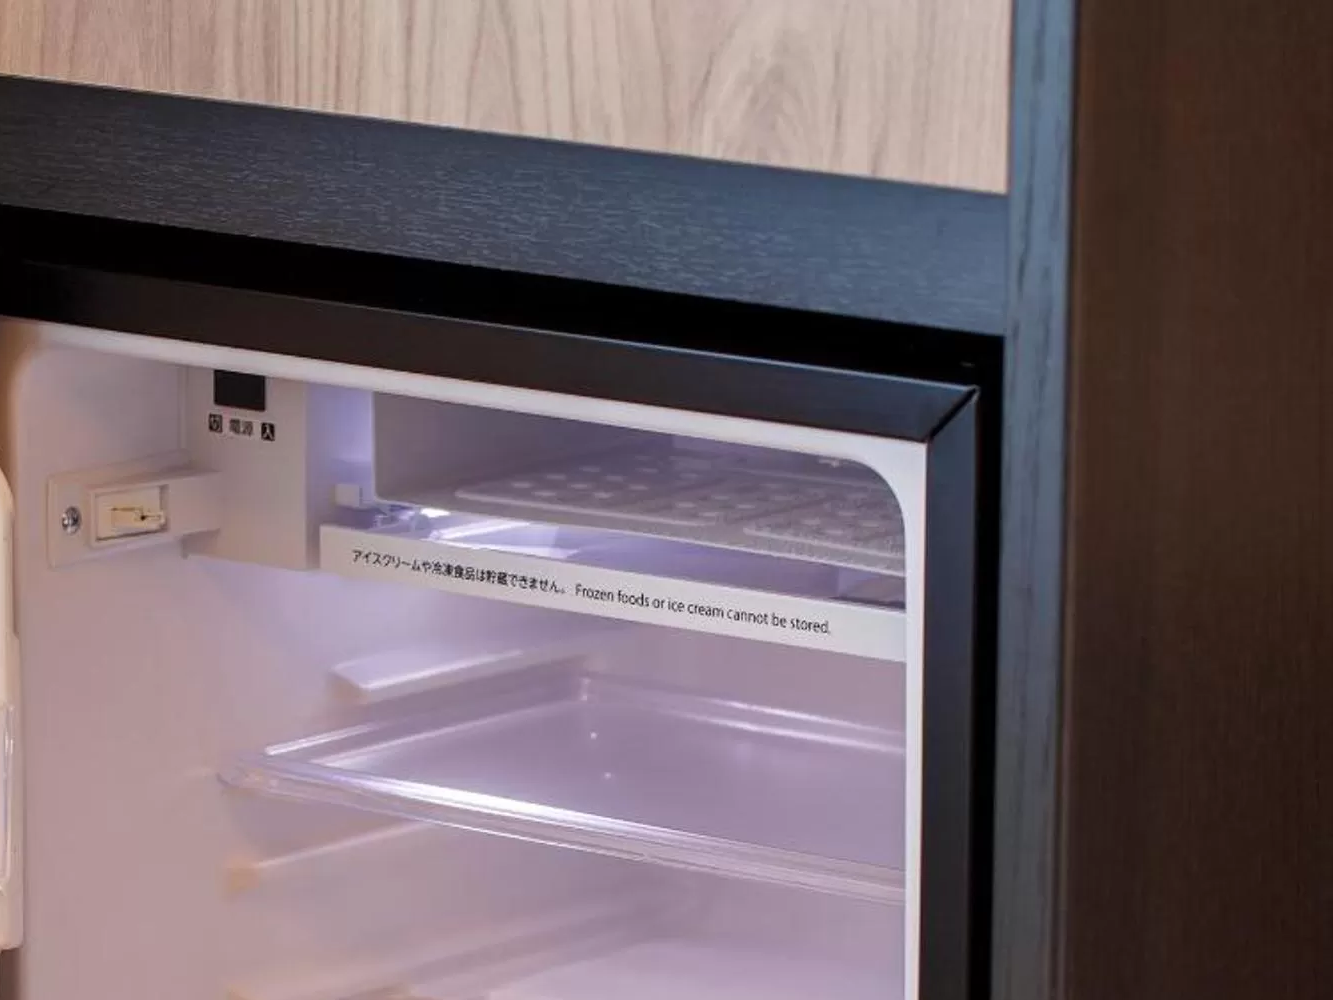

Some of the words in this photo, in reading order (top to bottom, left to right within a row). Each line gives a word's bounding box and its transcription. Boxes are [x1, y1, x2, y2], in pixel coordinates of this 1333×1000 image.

[229, 418, 253, 436] 電源
[261, 422, 275, 441] 入
[575, 583, 615, 601] Frozen
[617, 590, 649, 608] foods
[653, 598, 665, 610] or
[667, 597, 685, 612] ice
[687, 602, 724, 619] cream
[727, 608, 768, 626] cannot
[771, 612, 787, 629] be
[790, 618, 832, 635] stored.
